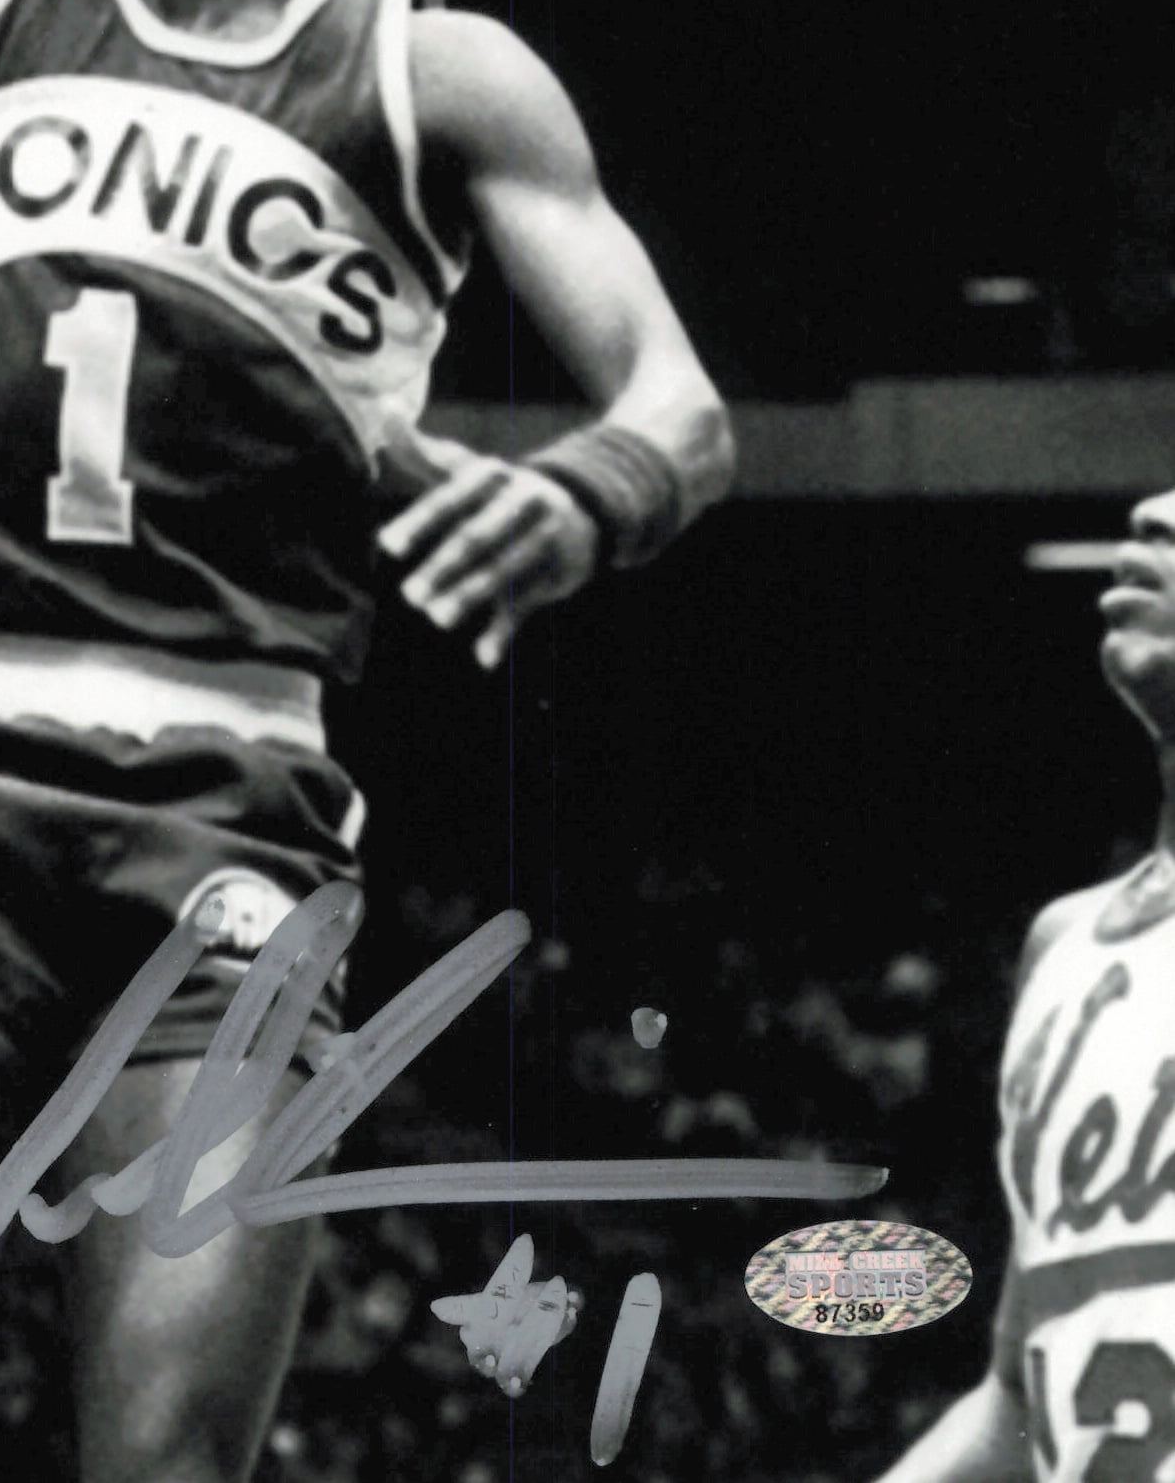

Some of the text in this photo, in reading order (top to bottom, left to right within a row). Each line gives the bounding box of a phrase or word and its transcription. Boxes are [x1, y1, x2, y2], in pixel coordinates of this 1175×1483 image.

[43, 288, 137, 546] 1
[851, 1250, 924, 1269] CREEK
[788, 1271, 925, 1300] SPORTS
[815, 1302, 885, 1323] 87359
